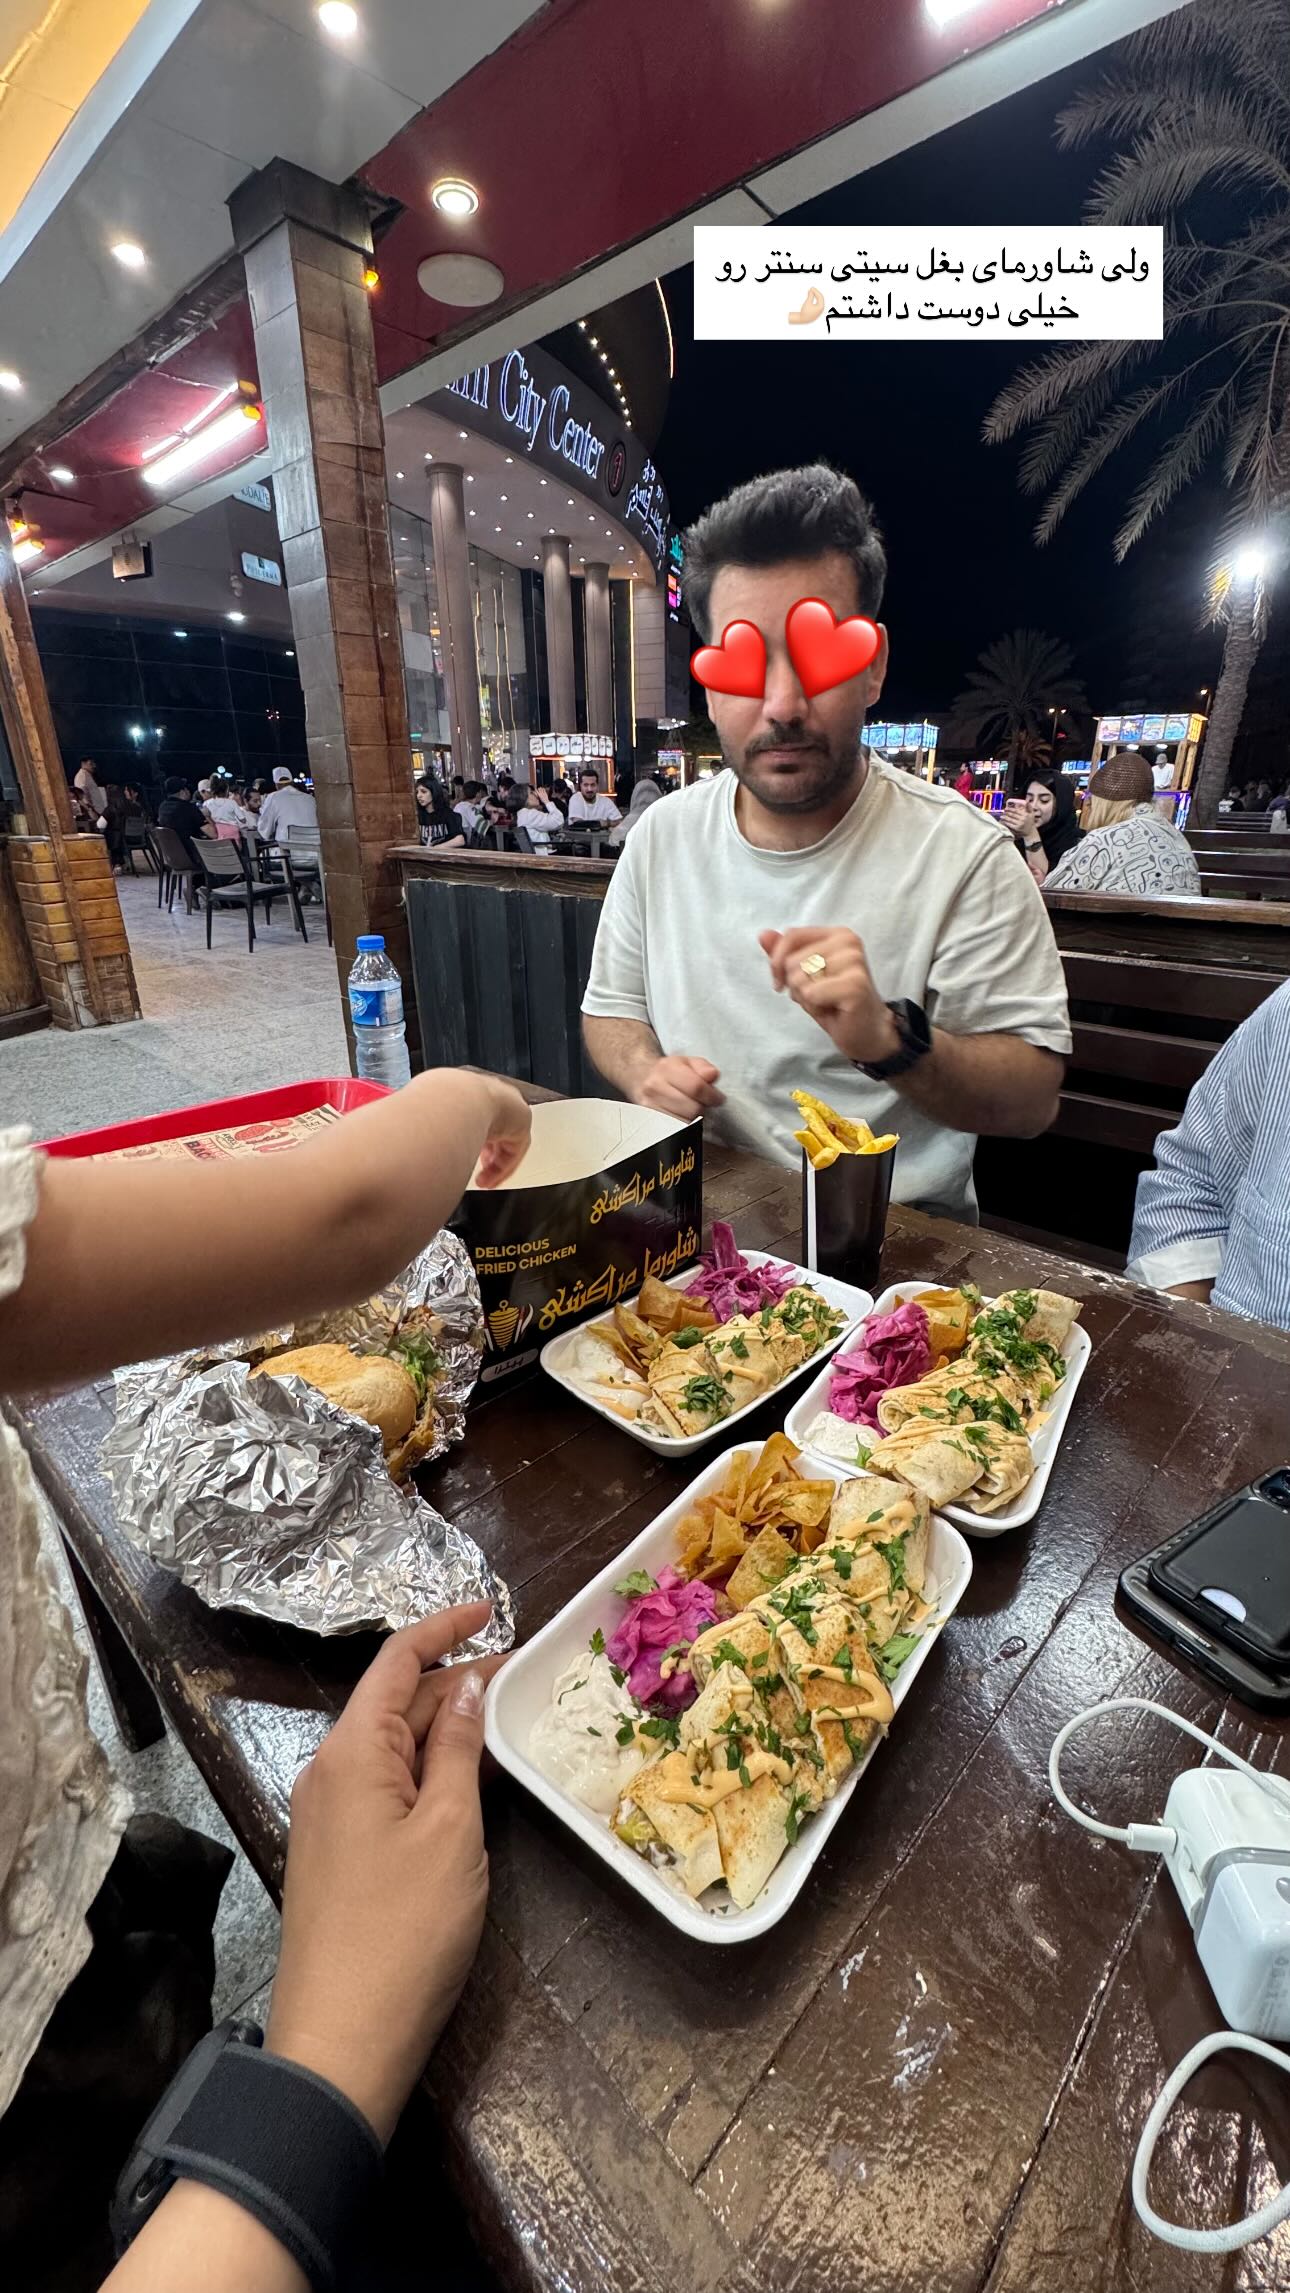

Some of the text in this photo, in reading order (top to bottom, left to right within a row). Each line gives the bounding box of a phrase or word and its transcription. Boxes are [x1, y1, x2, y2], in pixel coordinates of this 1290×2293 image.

[500, 349, 547, 452] City
[549, 384, 605, 480] Center
[659, 1146, 695, 1191] شاورما
[475, 1238, 550, 1260] DELICIOUS
[475, 1243, 577, 1276] FRIED CHICKEN
